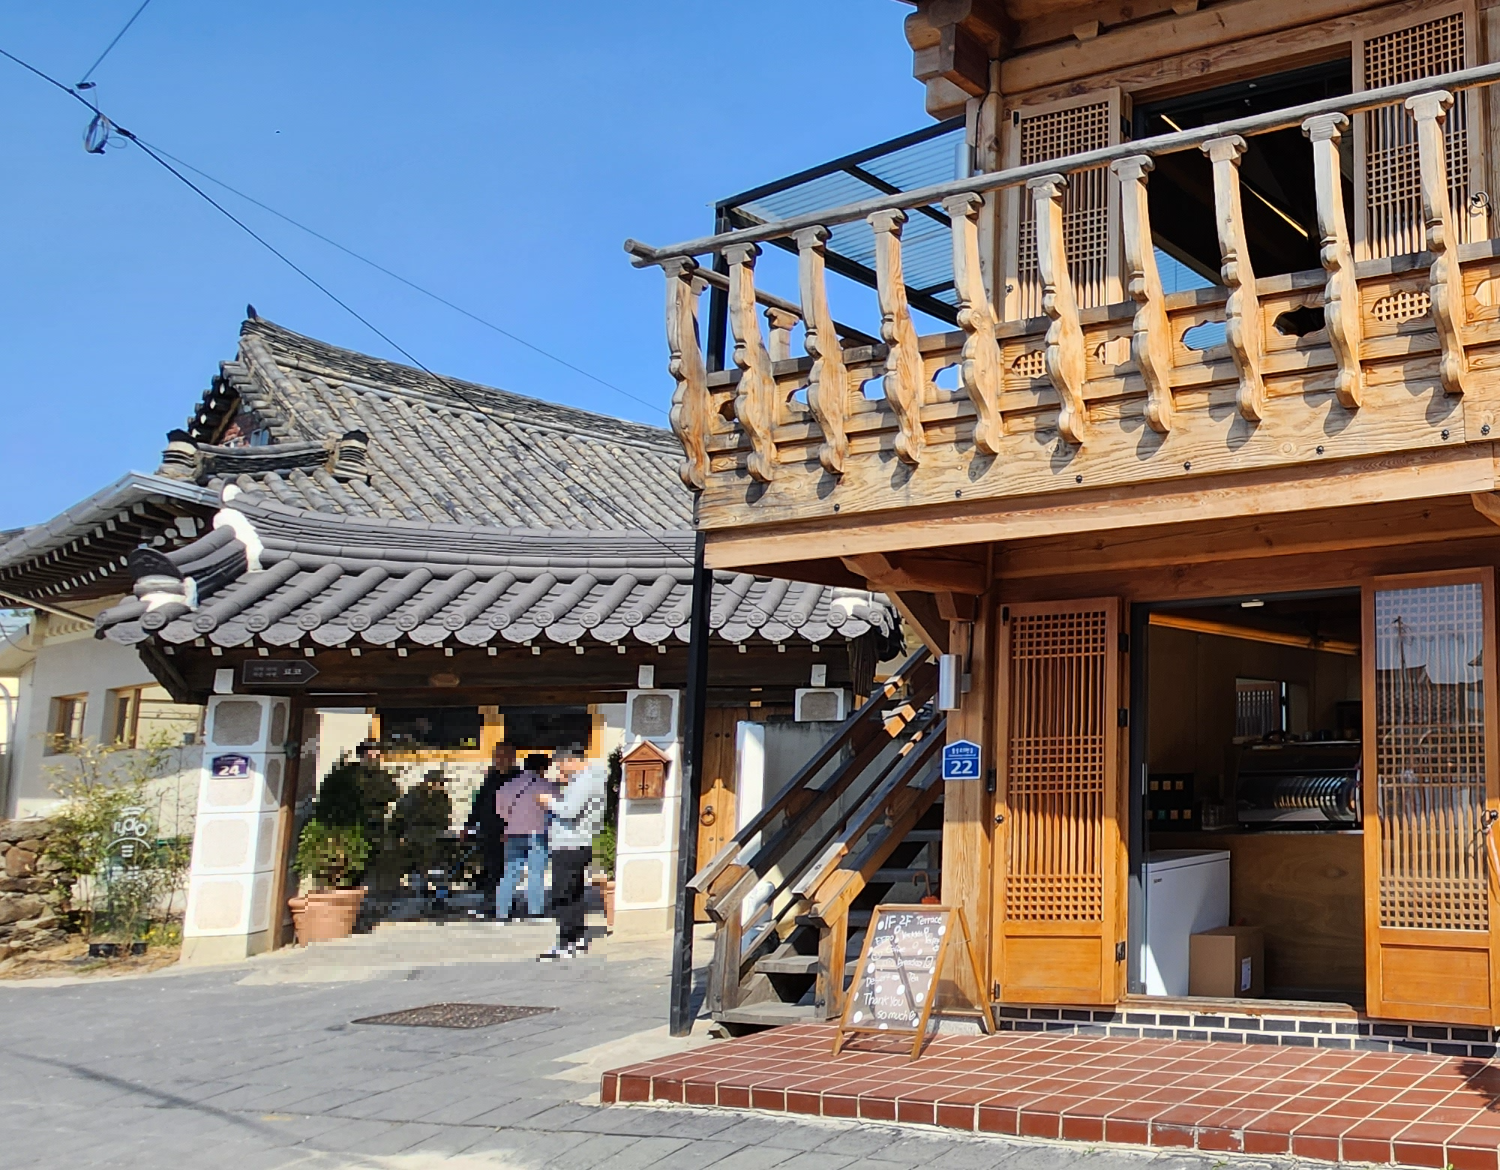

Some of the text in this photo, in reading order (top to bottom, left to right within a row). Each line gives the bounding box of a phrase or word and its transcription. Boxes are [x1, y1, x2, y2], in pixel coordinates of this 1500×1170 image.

[219, 765, 240, 776] 24
[950, 760, 973, 775] 22
[899, 914, 913, 927] 2F
[916, 915, 942, 926] Terrace
[863, 991, 890, 1006] Thank
[888, 1010, 908, 1020] much
